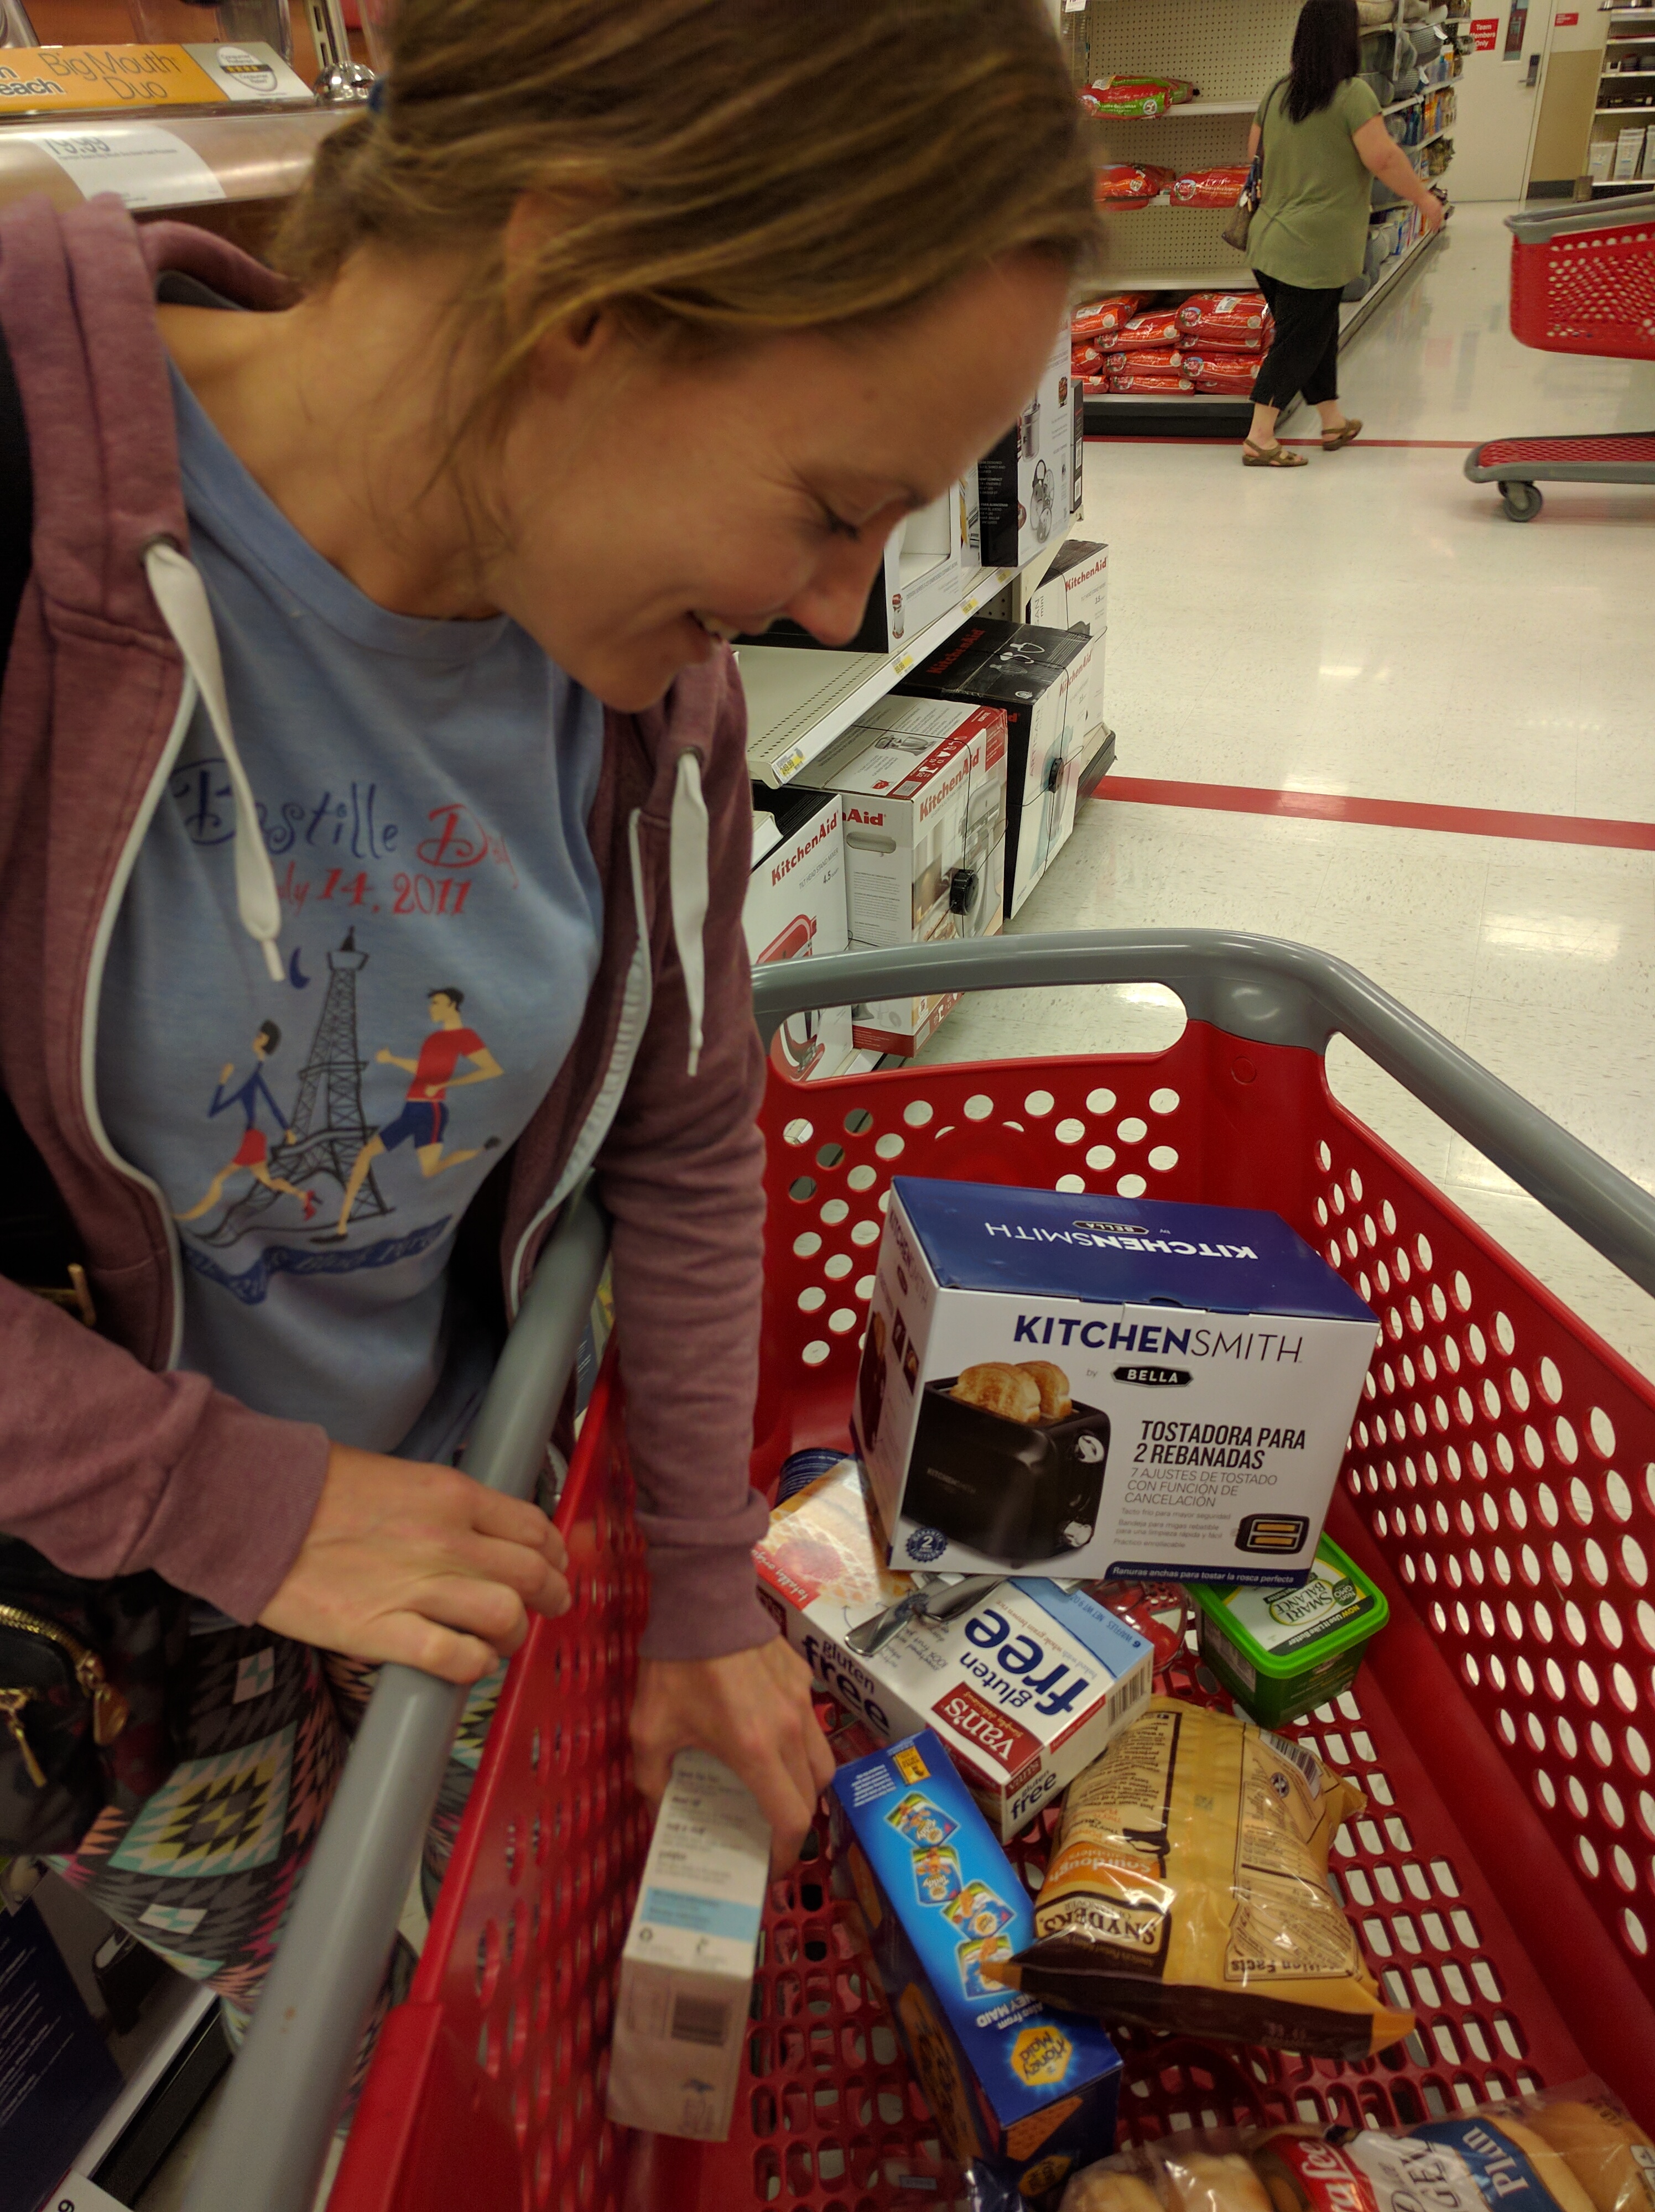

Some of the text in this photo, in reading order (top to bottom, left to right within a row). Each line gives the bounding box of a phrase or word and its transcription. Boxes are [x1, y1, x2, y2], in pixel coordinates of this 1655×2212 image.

[103, 76, 167, 100] Duo
[1065, 557, 1107, 592] KitchenAid
[1059, 649, 1092, 697] KitchenAid
[920, 748, 979, 822] KitchenAid
[168, 758, 398, 859] Bstille
[772, 812, 837, 886] KitchenAid
[823, 870, 831, 884] 4.5
[392, 872, 472, 915] 2011
[1086, 1223, 1135, 1233] BELLA
[985, 1222, 1258, 1260] KITCHENSMITH
[1013, 1314, 1303, 1363] KITCHENSMITH
[1086, 1368, 1179, 1384] by BELLA
[1141, 1420, 1306, 1450] TOSTADORA PARA
[1133, 1442, 1266, 1469] 2 REBANADAS
[1127, 1480, 1239, 1496] CON FUNCIÓN DE
[1131, 1468, 1278, 1485] 7 AJUSTES DE TOSTADO
[1125, 1492, 1216, 1507] CANCELACIÓN
[922, 1536, 933, 1548] 2
[775, 1567, 809, 1603] totally
[1113, 1566, 1294, 1584] Ranuras anchas para tostar la rosca perfecta
[1274, 1582, 1326, 1615] BALANCE
[1334, 1584, 1353, 1598] GMO
[996, 1600, 1008, 1611] rice
[1082, 1604, 1095, 1615] WT
[1094, 1611, 1106, 1622] NET
[1286, 1590, 1333, 1623] SMART
[1342, 1604, 1361, 1618] NOW
[1008, 1609, 1028, 1627] brown
[1310, 1621, 1324, 1635] Like
[1330, 1614, 1342, 1624] Use
[1027, 1623, 1047, 1640] grain
[1107, 1620, 1133, 1642] WAFFLES
[1288, 1630, 1311, 1646] Butter
[1044, 1637, 1063, 1652] whole
[1132, 1640, 1141, 1648] 6
[822, 1641, 875, 1695] gluten
[964, 1607, 1090, 1717] free
[803, 1634, 890, 1737] free
[959, 1651, 1034, 1709] gluten
[944, 1697, 1014, 1761] van's
[1021, 1770, 1049, 1797] gluten
[1011, 1772, 1057, 1820] free
[1231, 1959, 1276, 1974] Facts
[976, 1994, 1037, 2028] NEY MAID
[997, 2012, 1023, 2030] from
[1019, 2030, 1054, 2062] Maid
[1023, 2038, 1067, 2080] Honey
